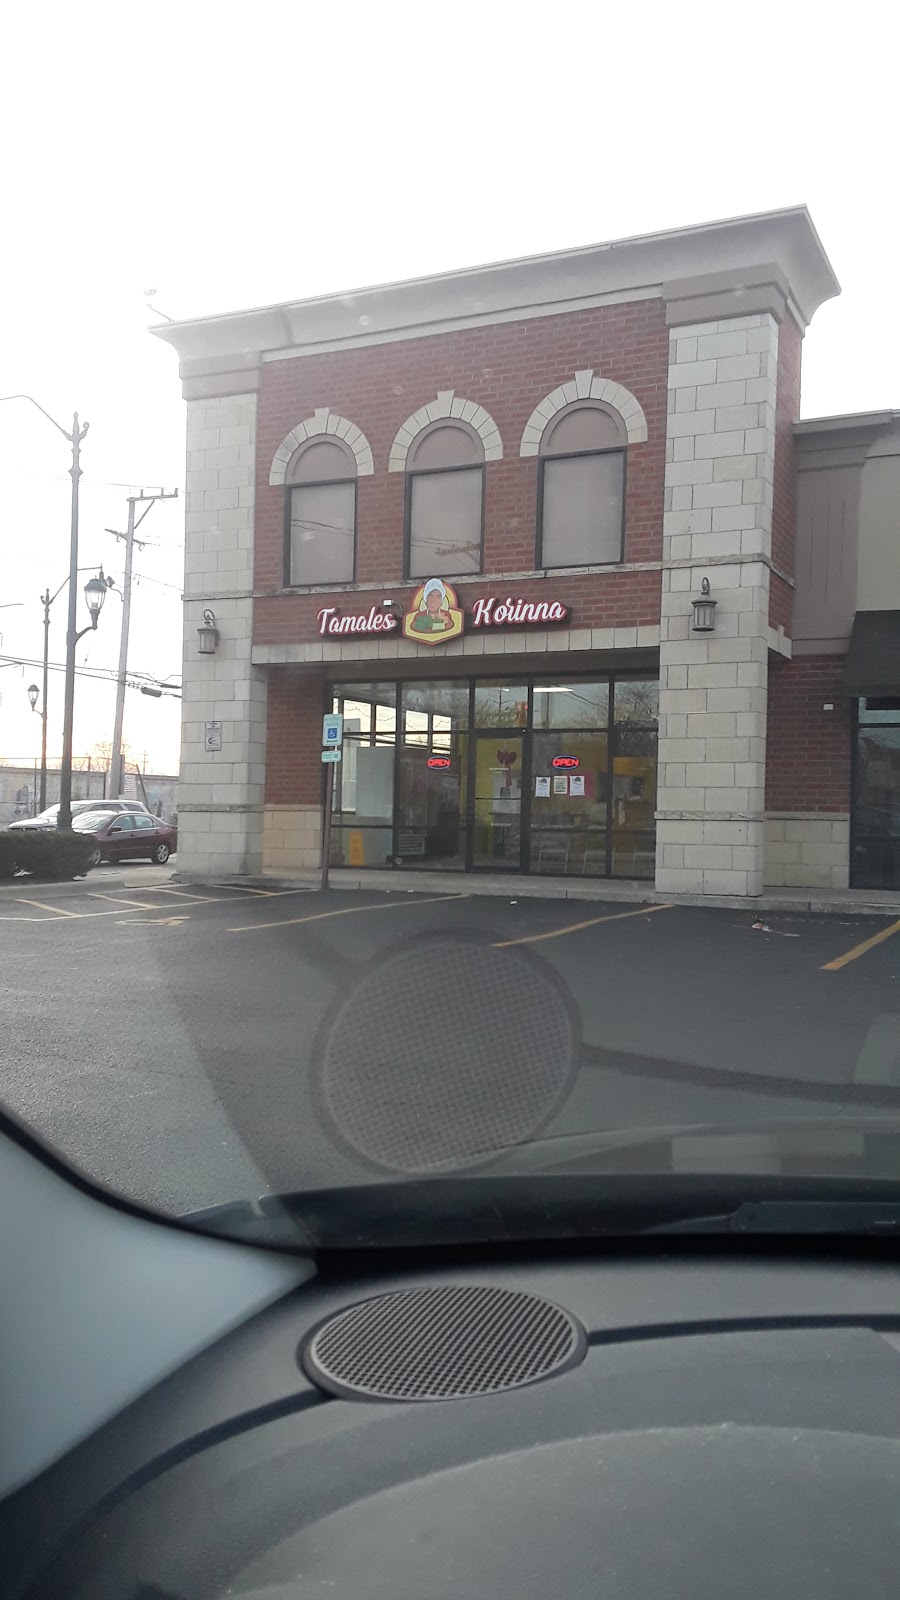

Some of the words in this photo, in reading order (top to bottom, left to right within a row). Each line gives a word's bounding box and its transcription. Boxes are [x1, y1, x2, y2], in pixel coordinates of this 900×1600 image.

[317, 606, 396, 634] Tamales
[473, 597, 566, 626] Korinna
[427, 758, 451, 768] OPEN
[552, 757, 579, 767] OPEN
